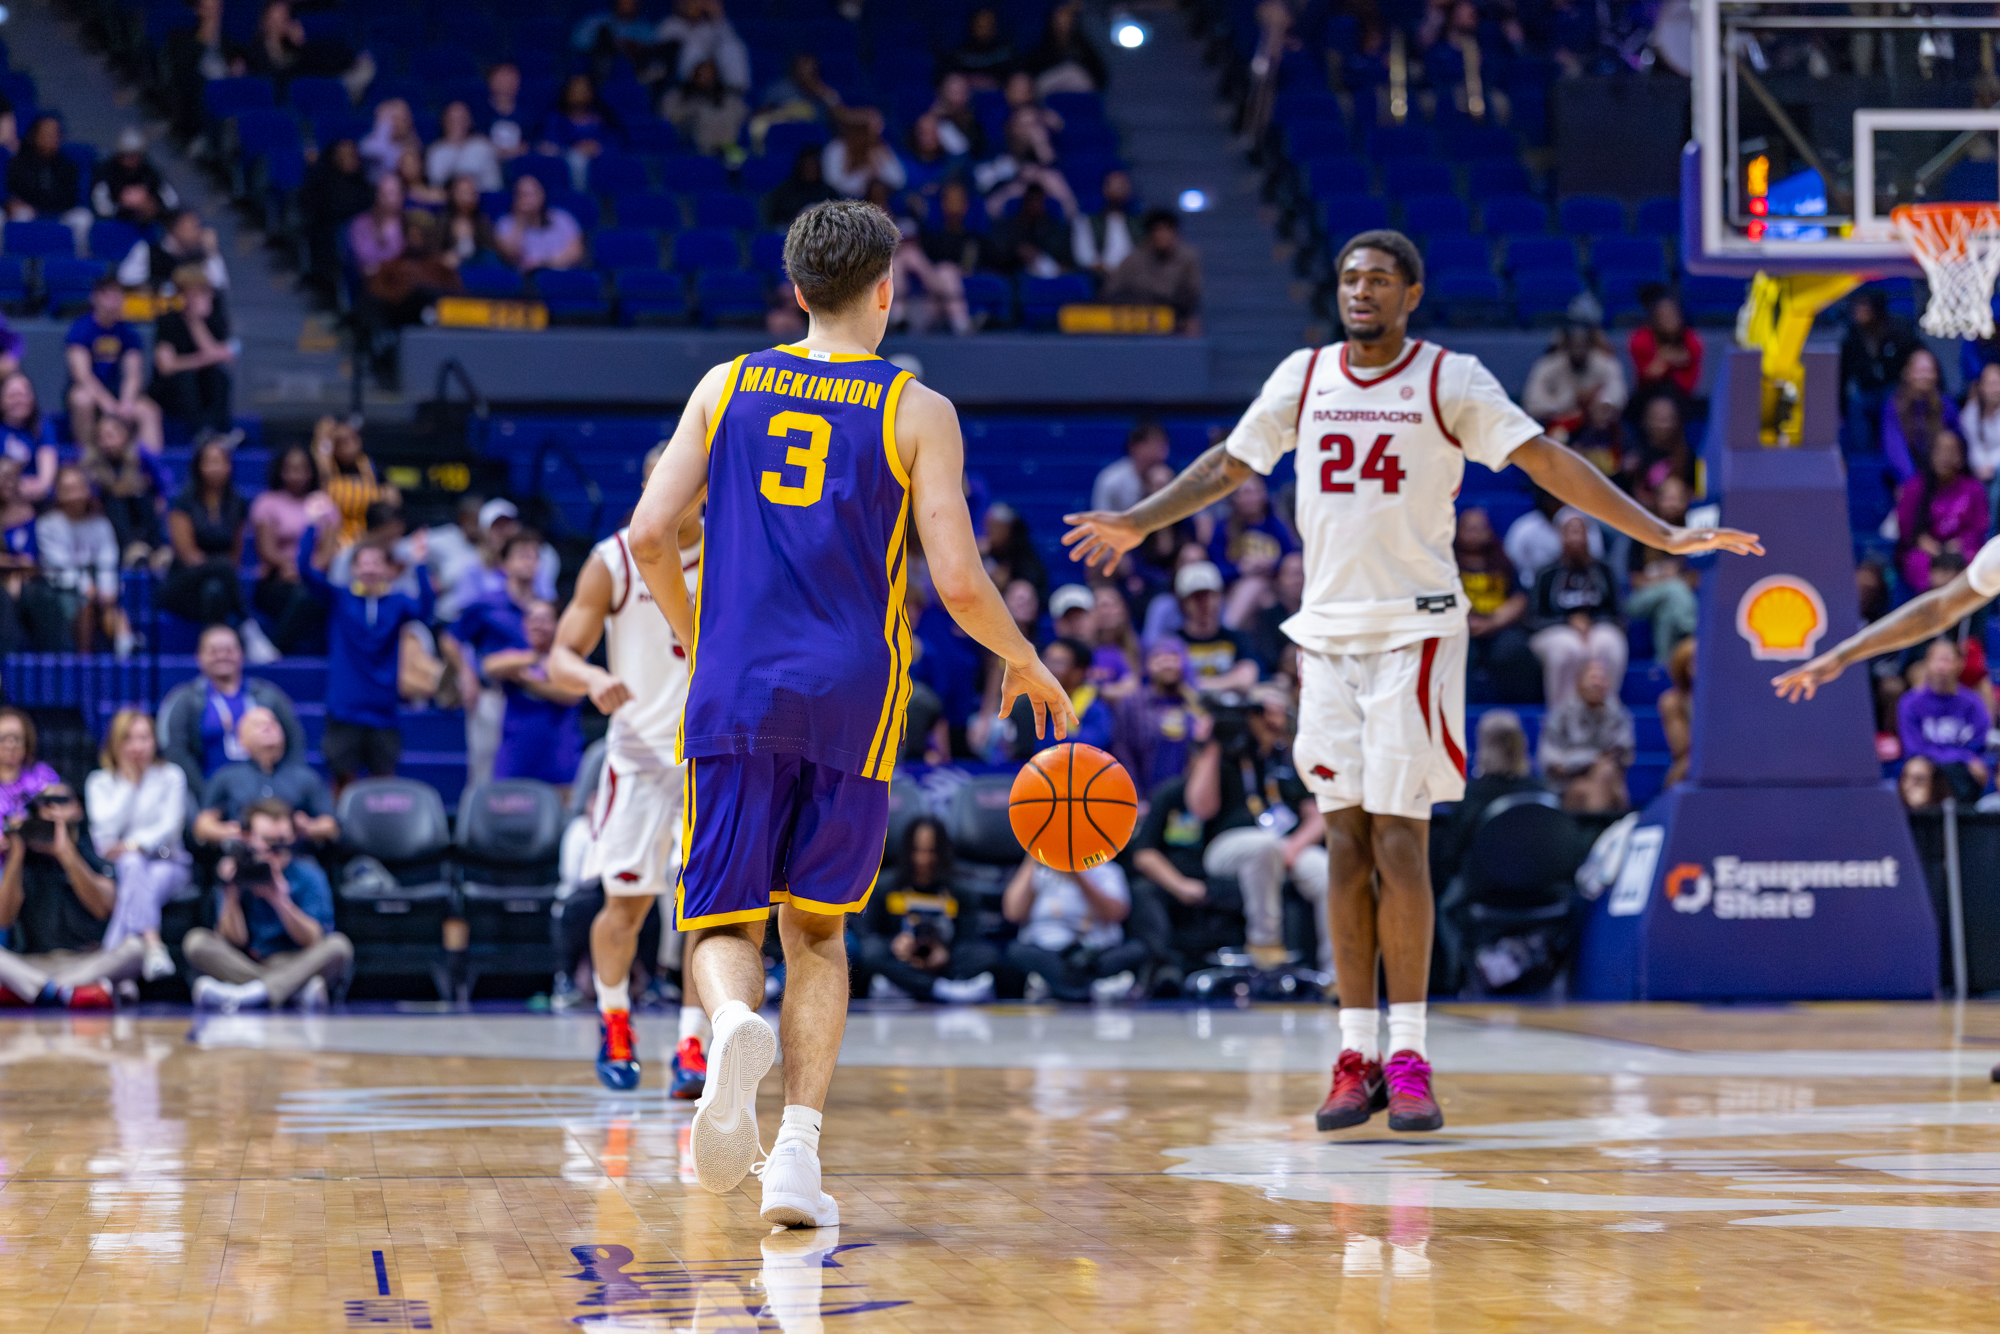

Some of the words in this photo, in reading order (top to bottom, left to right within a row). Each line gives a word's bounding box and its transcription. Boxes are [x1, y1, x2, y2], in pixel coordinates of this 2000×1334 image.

[739, 366, 883, 409] MACKINNON
[1313, 410, 1422, 424] RAZORBACKS
[760, 410, 832, 507] 3
[1319, 433, 1406, 493] 24
[1713, 855, 1898, 891] Equipment
[1713, 889, 1815, 919] Share
